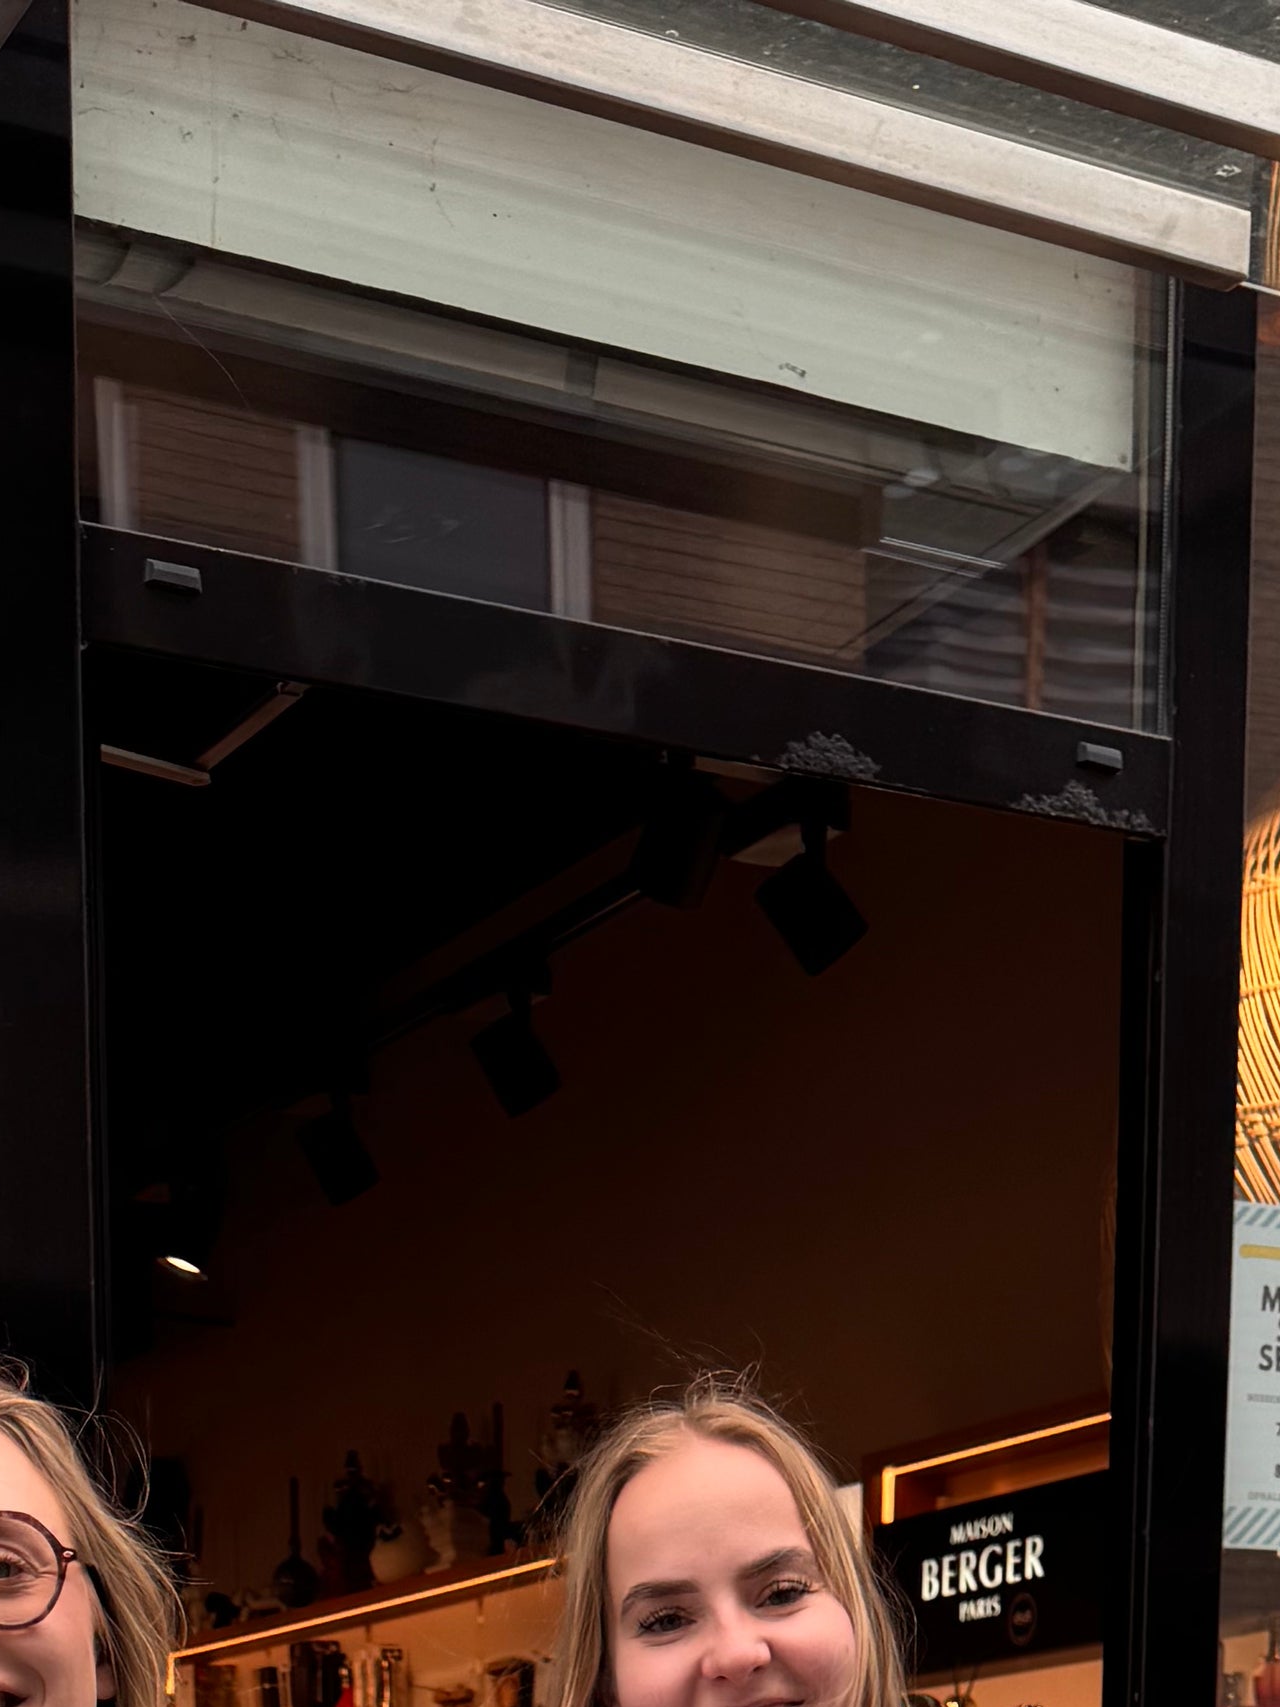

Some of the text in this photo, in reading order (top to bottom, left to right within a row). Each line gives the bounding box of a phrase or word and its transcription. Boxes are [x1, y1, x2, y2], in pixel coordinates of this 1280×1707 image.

[950, 1511, 1014, 1545] MAISON
[921, 1535, 1045, 1602] BERGER
[959, 1594, 1002, 1623] PARIS
